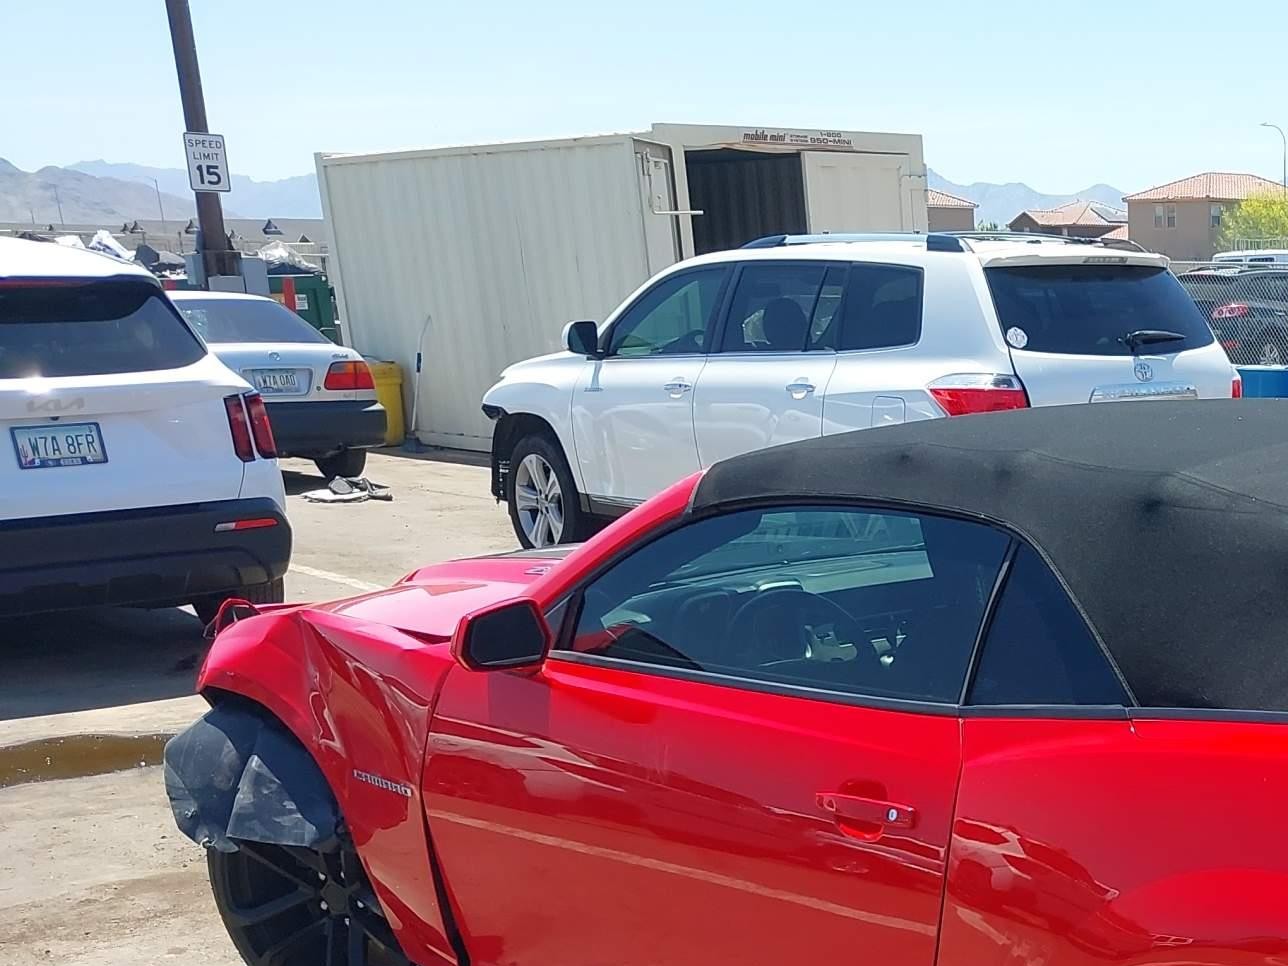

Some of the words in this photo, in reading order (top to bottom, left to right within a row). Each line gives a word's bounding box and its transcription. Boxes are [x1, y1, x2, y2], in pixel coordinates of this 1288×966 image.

[187, 138, 222, 149] SPEED
[743, 130, 768, 142] mobile
[769, 132, 786, 142] mini
[193, 151, 219, 161] LIMIT
[196, 164, 222, 185] 15
[28, 435, 62, 457] W7A
[65, 433, 97, 455] 8FR
[353, 769, 412, 797] CAMARO
